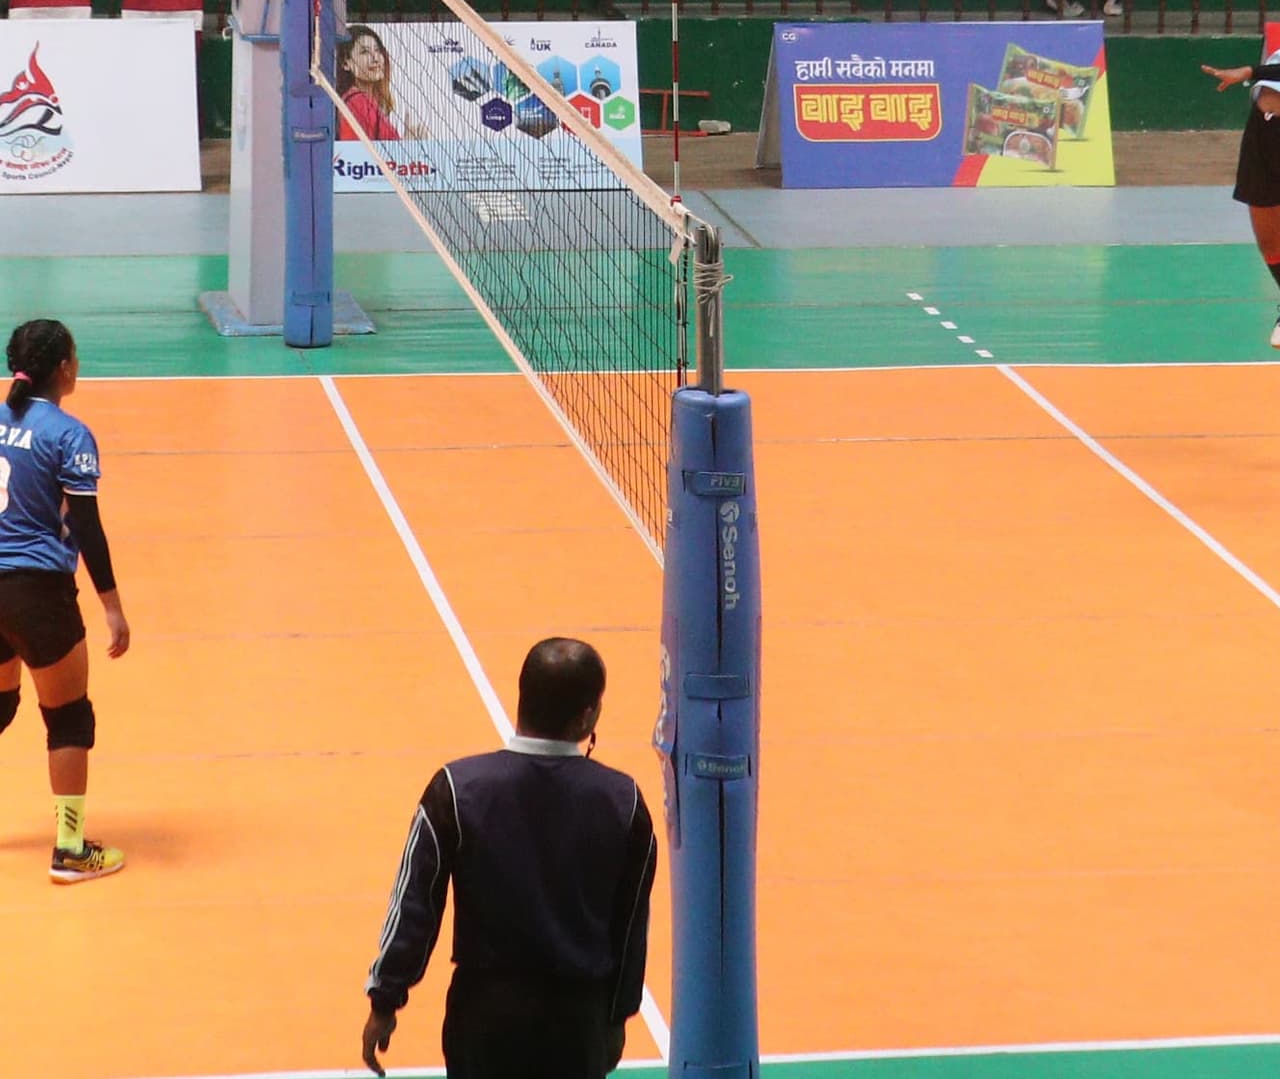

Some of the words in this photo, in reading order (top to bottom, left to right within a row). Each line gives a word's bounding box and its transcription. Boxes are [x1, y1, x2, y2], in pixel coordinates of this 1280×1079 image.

[536, 43, 551, 52] UK
[795, 56, 832, 81] हामी
[834, 54, 886, 79] सबैको
[722, 525, 741, 610] Senoh
